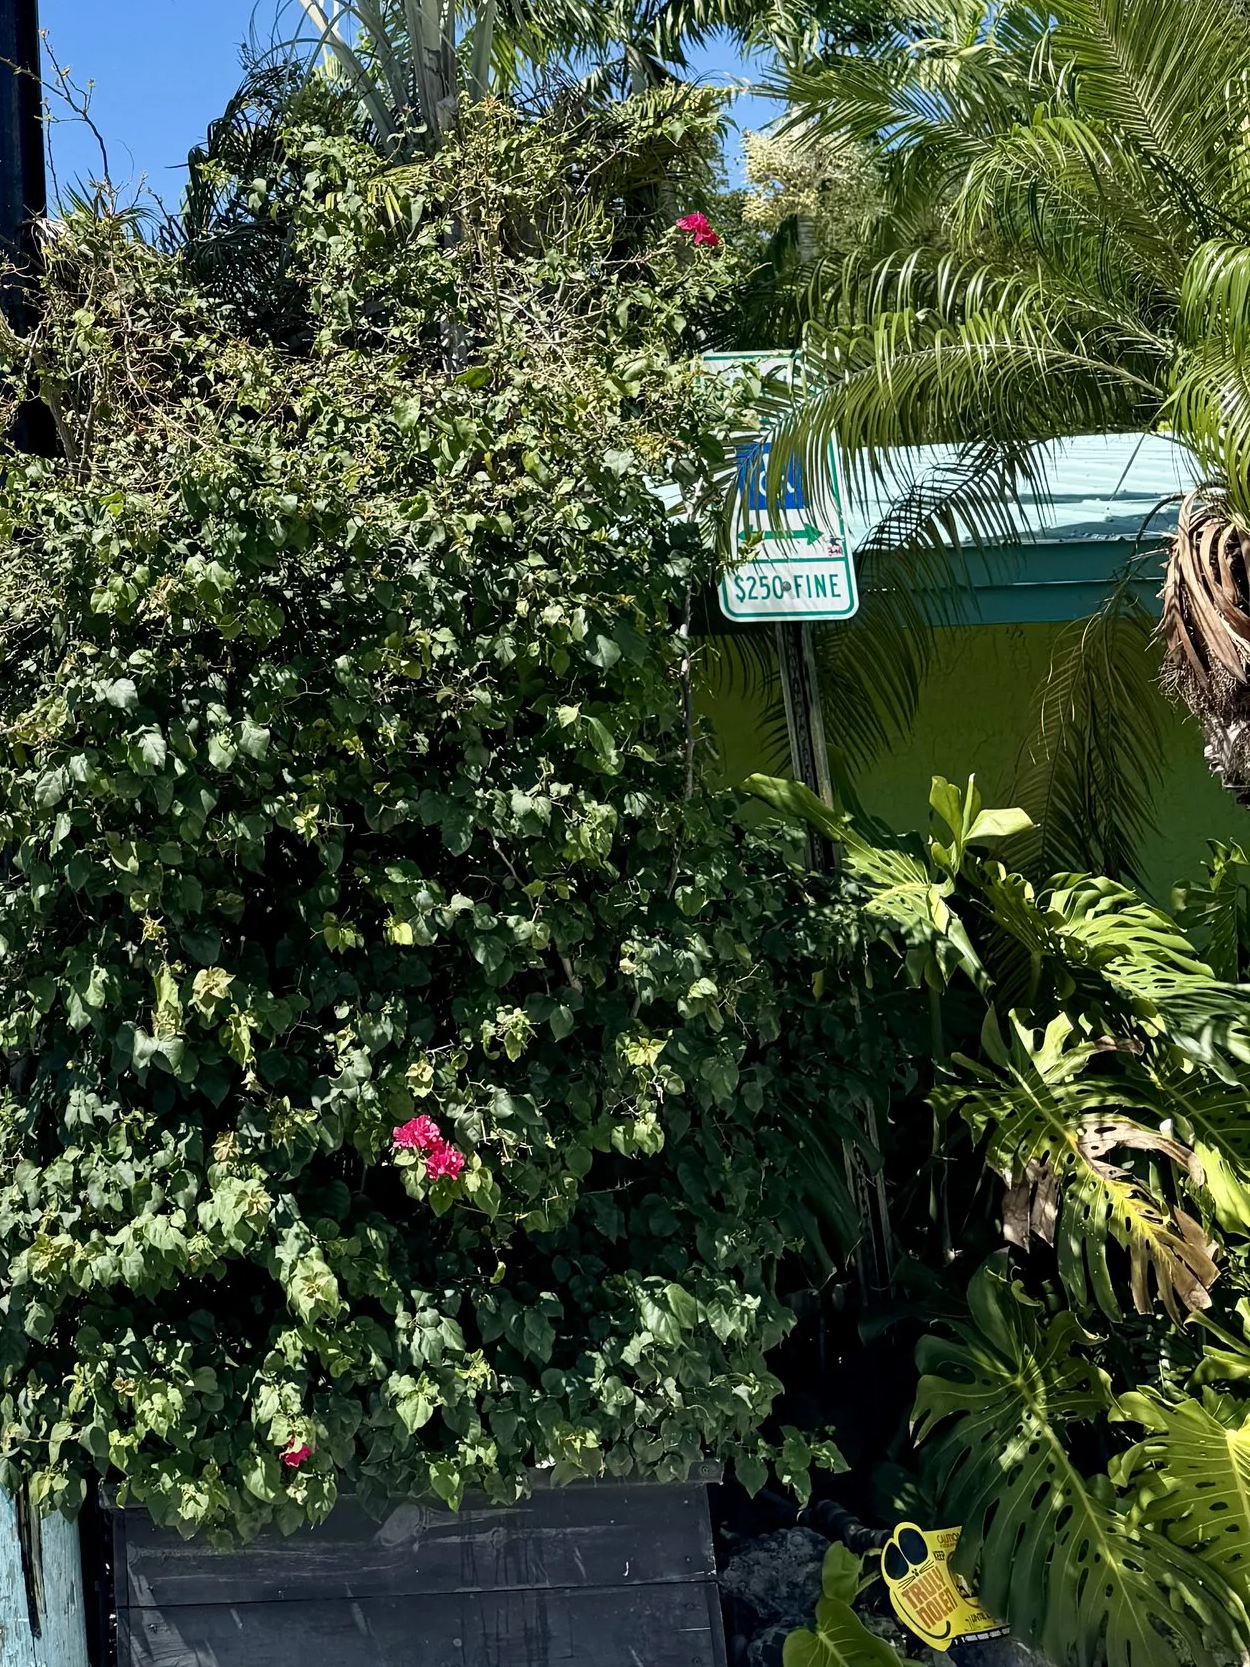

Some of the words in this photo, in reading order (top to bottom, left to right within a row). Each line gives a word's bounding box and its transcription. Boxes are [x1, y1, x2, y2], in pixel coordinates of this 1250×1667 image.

[735, 574, 784, 603] $250
[794, 573, 841, 599] FINE
[901, 1566, 946, 1610] TRULY
